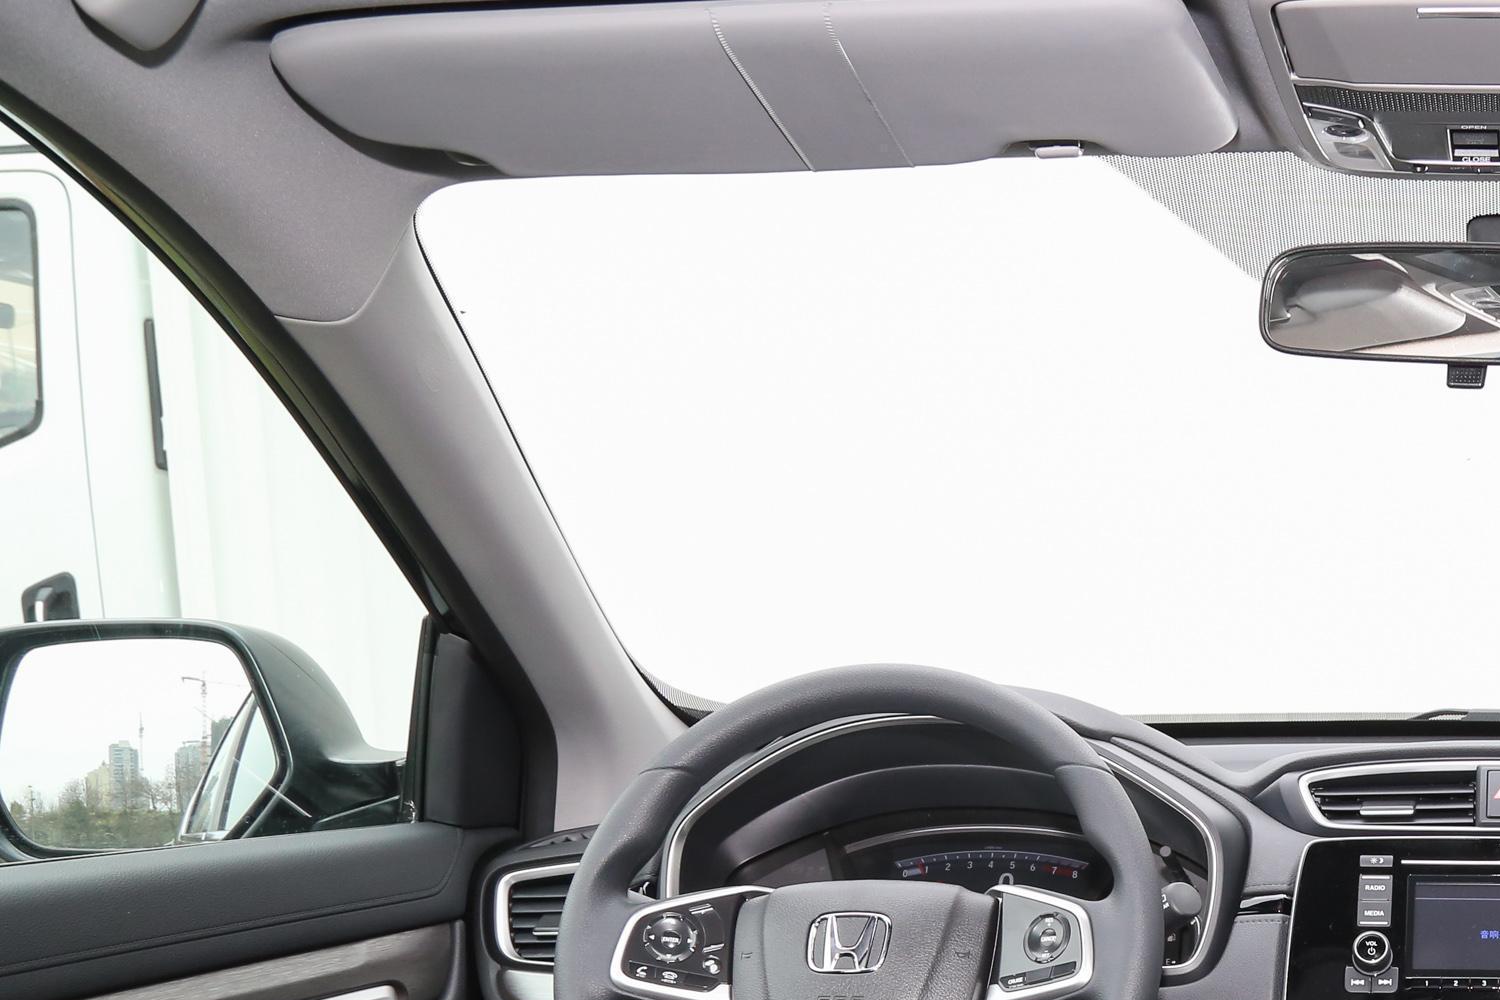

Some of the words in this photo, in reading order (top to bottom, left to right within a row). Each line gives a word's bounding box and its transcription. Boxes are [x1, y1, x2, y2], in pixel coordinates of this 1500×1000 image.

[902, 869, 908, 878] 0
[925, 866, 929, 874] 1
[945, 863, 951, 871] 2
[967, 861, 973, 869] 3
[987, 861, 994, 869] 4
[1009, 861, 1016, 870] 5
[1030, 863, 1036, 871] 6
[1051, 866, 1057, 875] 7
[1071, 870, 1078, 879] 8
